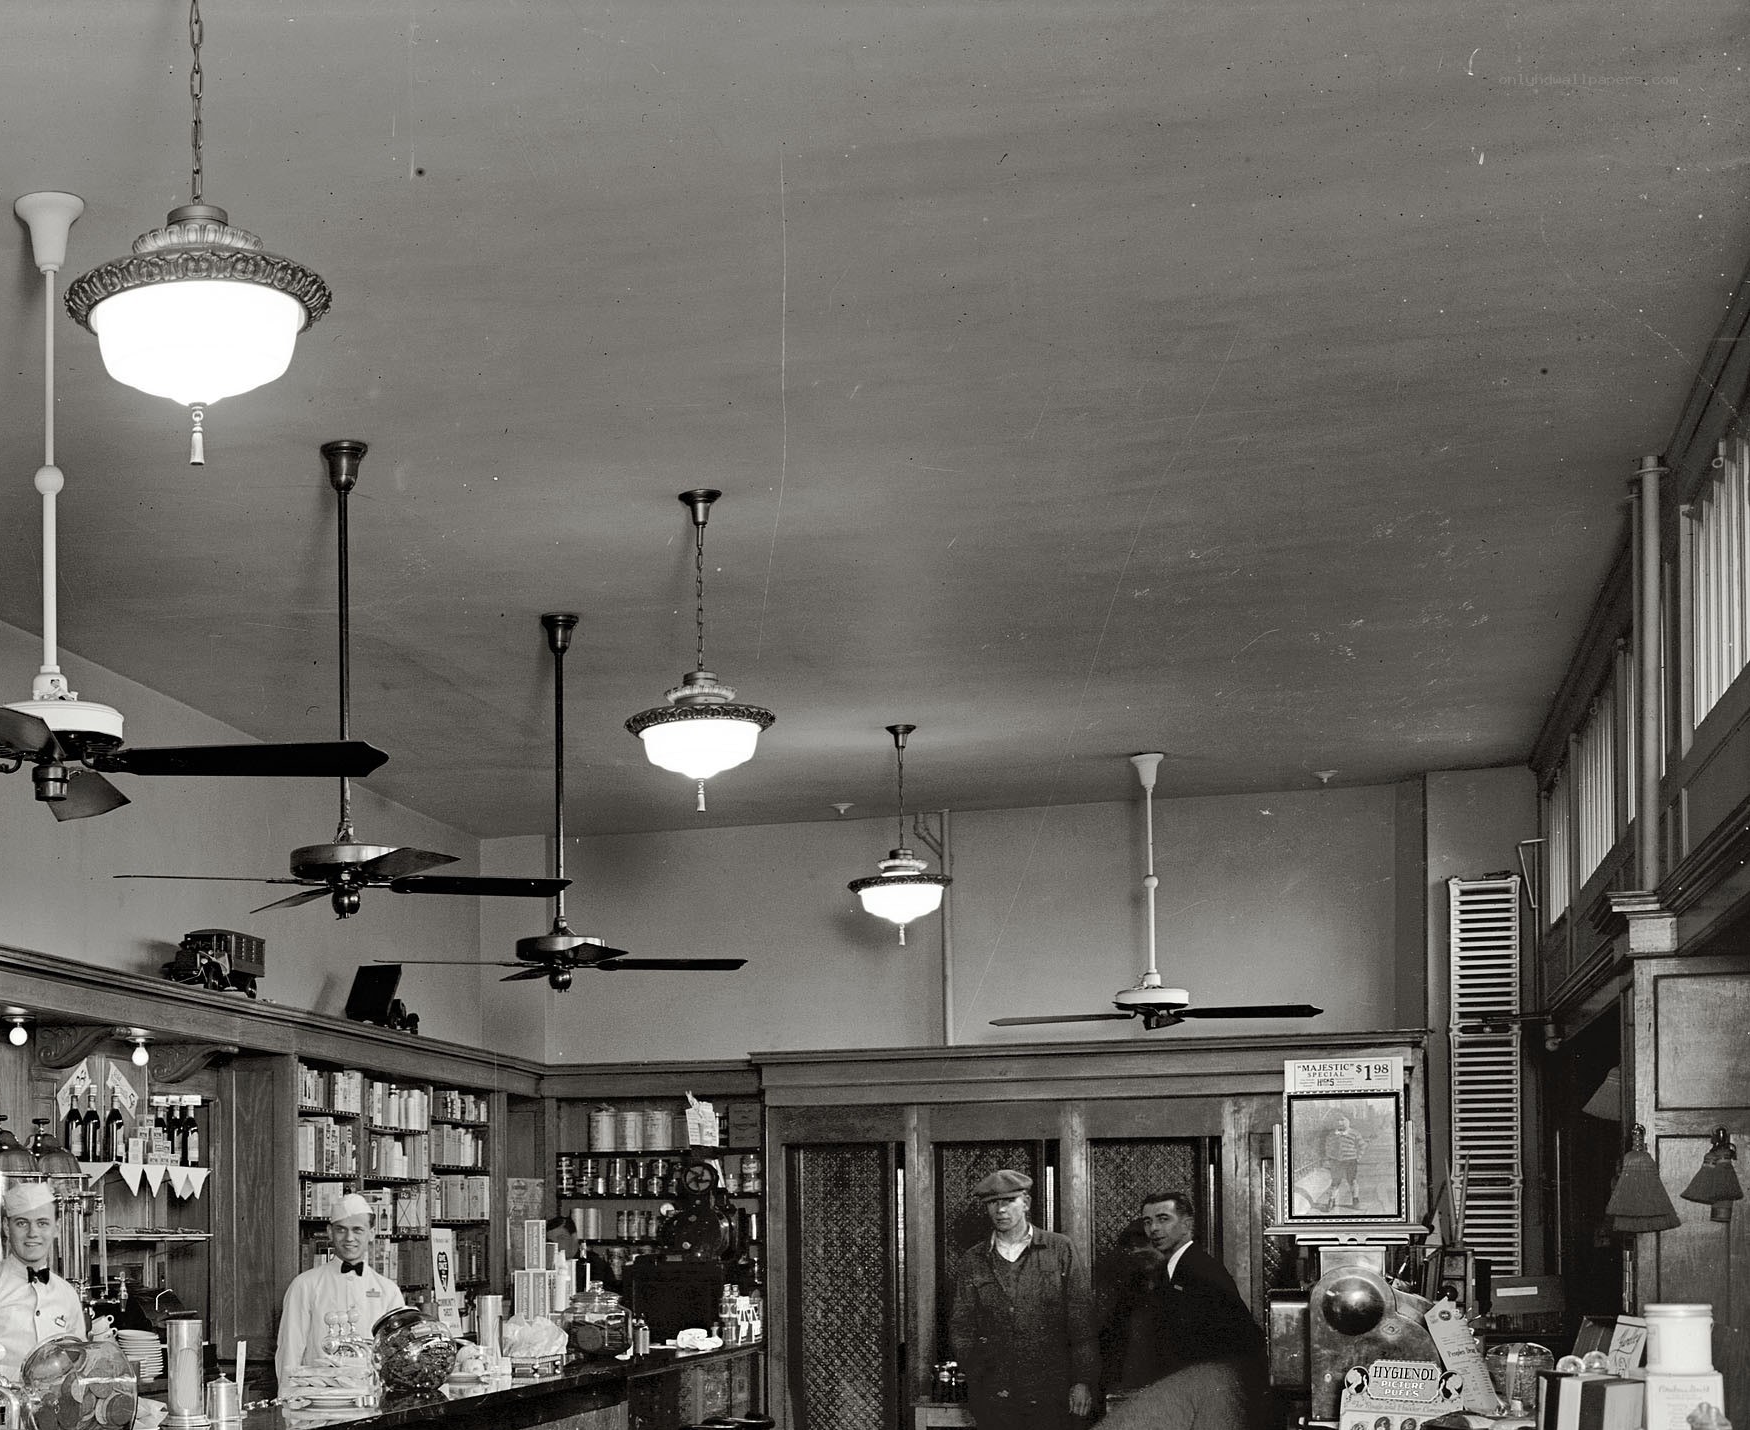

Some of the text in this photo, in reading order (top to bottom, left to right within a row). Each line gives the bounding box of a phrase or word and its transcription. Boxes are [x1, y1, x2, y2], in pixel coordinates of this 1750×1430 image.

[1373, 1366, 1437, 1381] HYGIENOL
[1381, 1381, 1425, 1390] PICTURE
[1384, 1389, 1419, 1397] PUFFS
